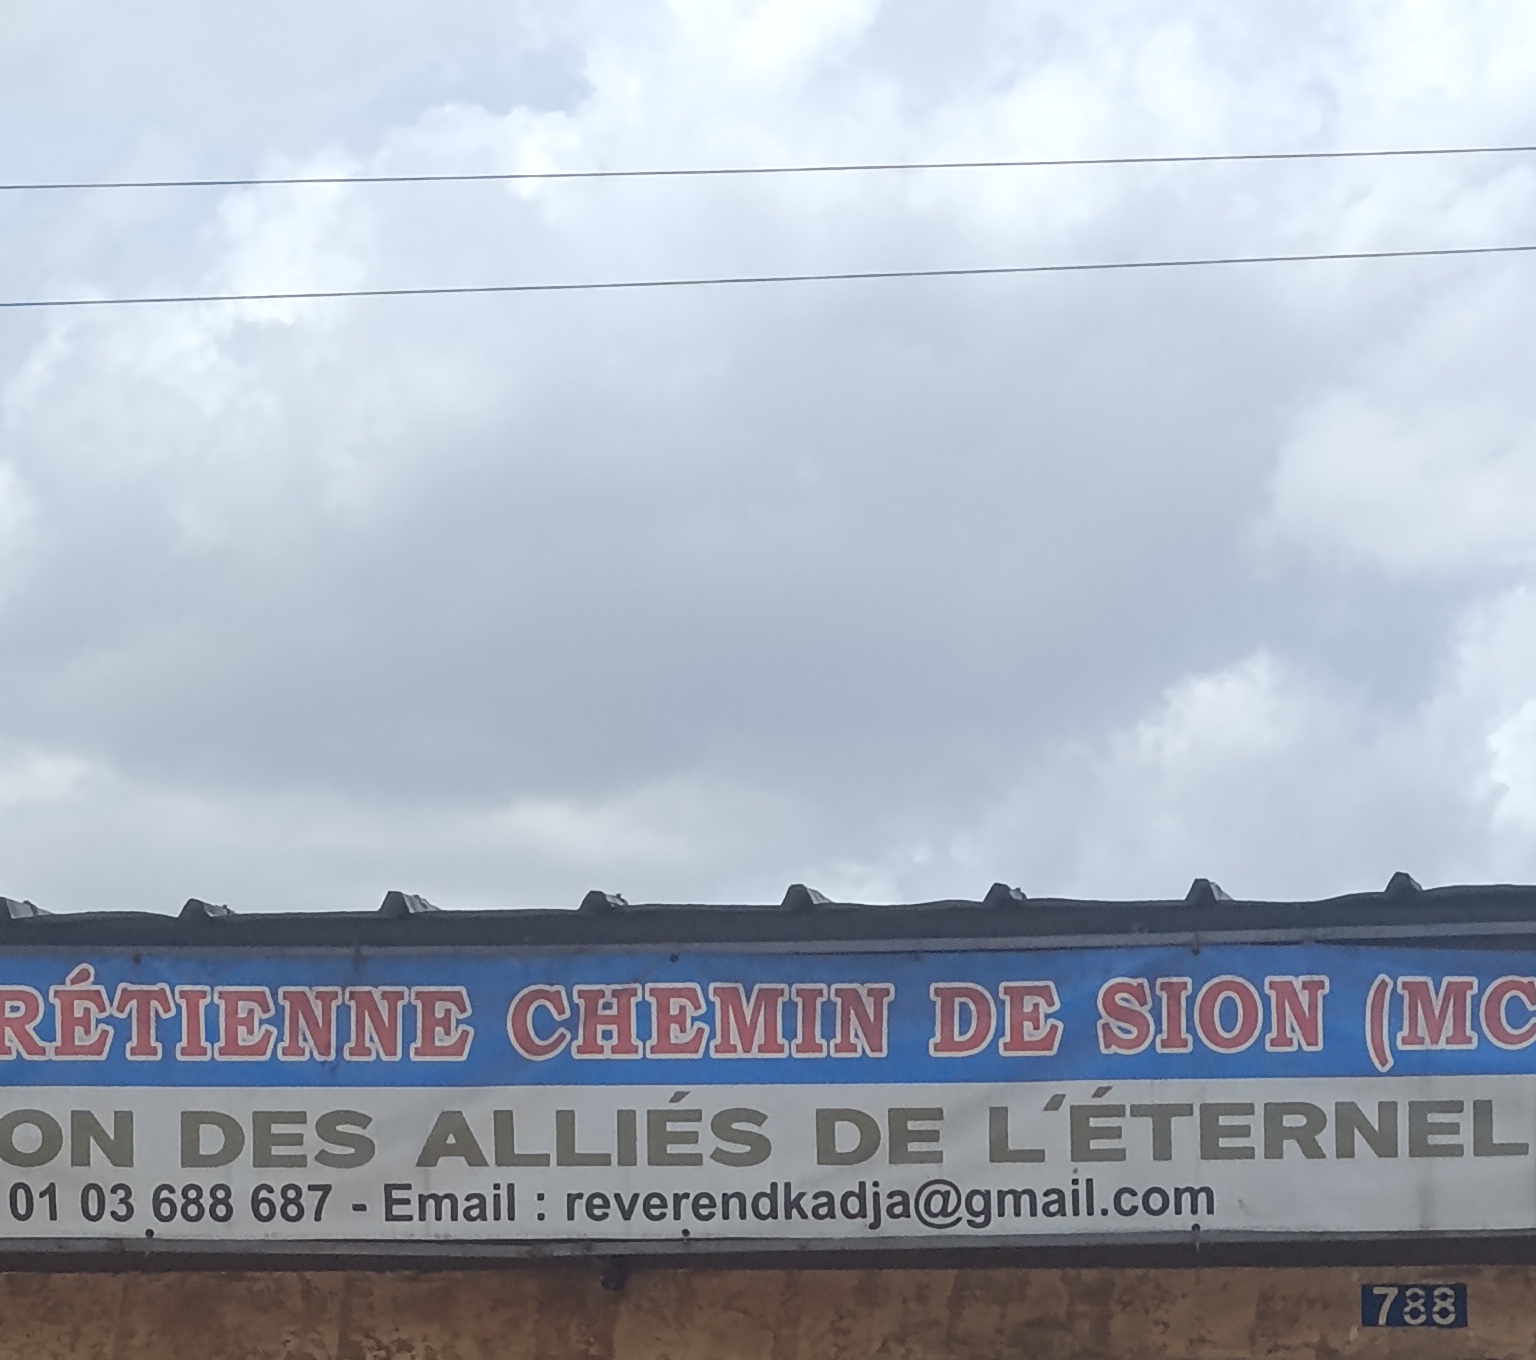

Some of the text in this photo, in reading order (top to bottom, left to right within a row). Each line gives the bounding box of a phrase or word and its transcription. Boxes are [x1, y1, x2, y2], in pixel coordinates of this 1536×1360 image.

[0, 963, 472, 1061] RÉTIENNE
[507, 983, 896, 1060] CHEMIN
[928, 981, 1063, 1057] DE
[1097, 975, 1329, 1055] SION
[0, 1108, 134, 1168] ON
[180, 1109, 376, 1169] DES
[415, 1090, 772, 1168] ALLIÉS
[815, 1107, 943, 1166] DE
[9, 1181, 58, 1222] 01
[80, 1182, 134, 1222] 03
[152, 1183, 234, 1223] 688
[250, 1183, 332, 1223] 687
[384, 1183, 515, 1222] Email
[567, 1177, 1215, 1230] reverendkadja@gmail.com
[1372, 1286, 1456, 1325] 788
